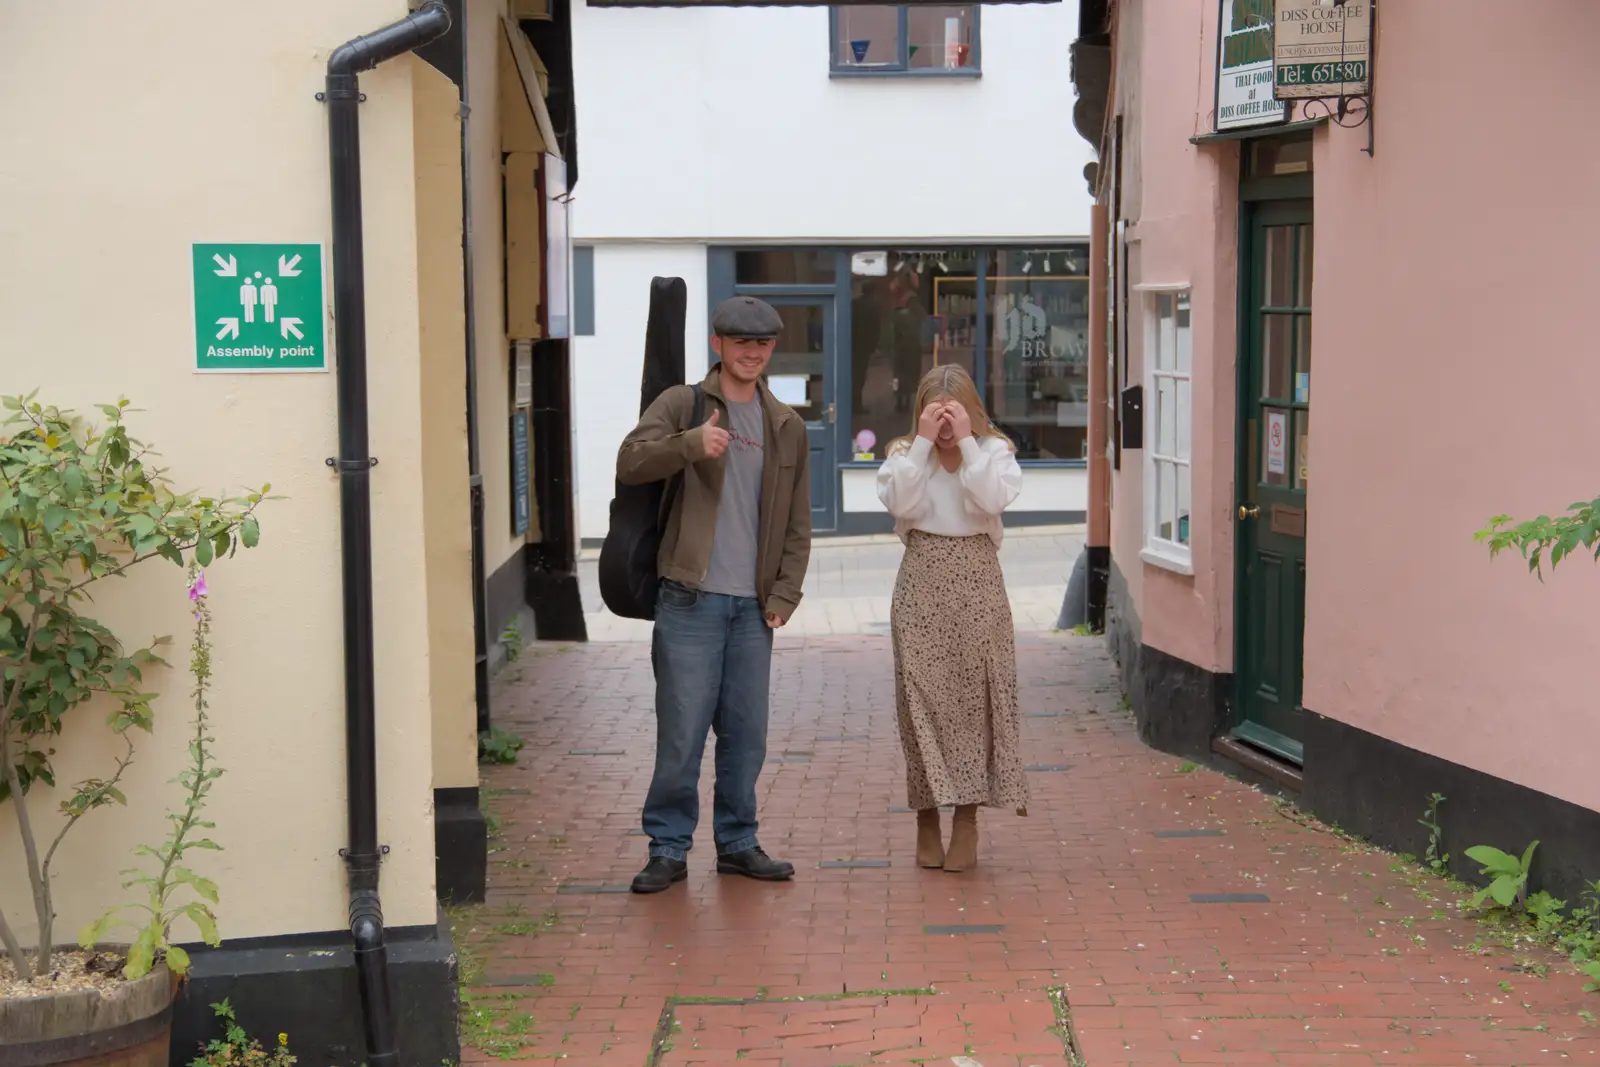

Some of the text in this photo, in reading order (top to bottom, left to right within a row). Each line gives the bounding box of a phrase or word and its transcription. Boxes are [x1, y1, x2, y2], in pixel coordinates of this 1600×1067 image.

[1281, 5, 1363, 22] DISS COFFEE
[1300, 21, 1343, 35] HOUSE
[1235, 70, 1272, 88] THAI FOOD
[1280, 62, 1363, 83] Tel: 651580
[1248, 88, 1256, 100] at
[1220, 99, 1284, 119] DISS COFFEE HOUSE
[207, 345, 314, 359] Assembly point
